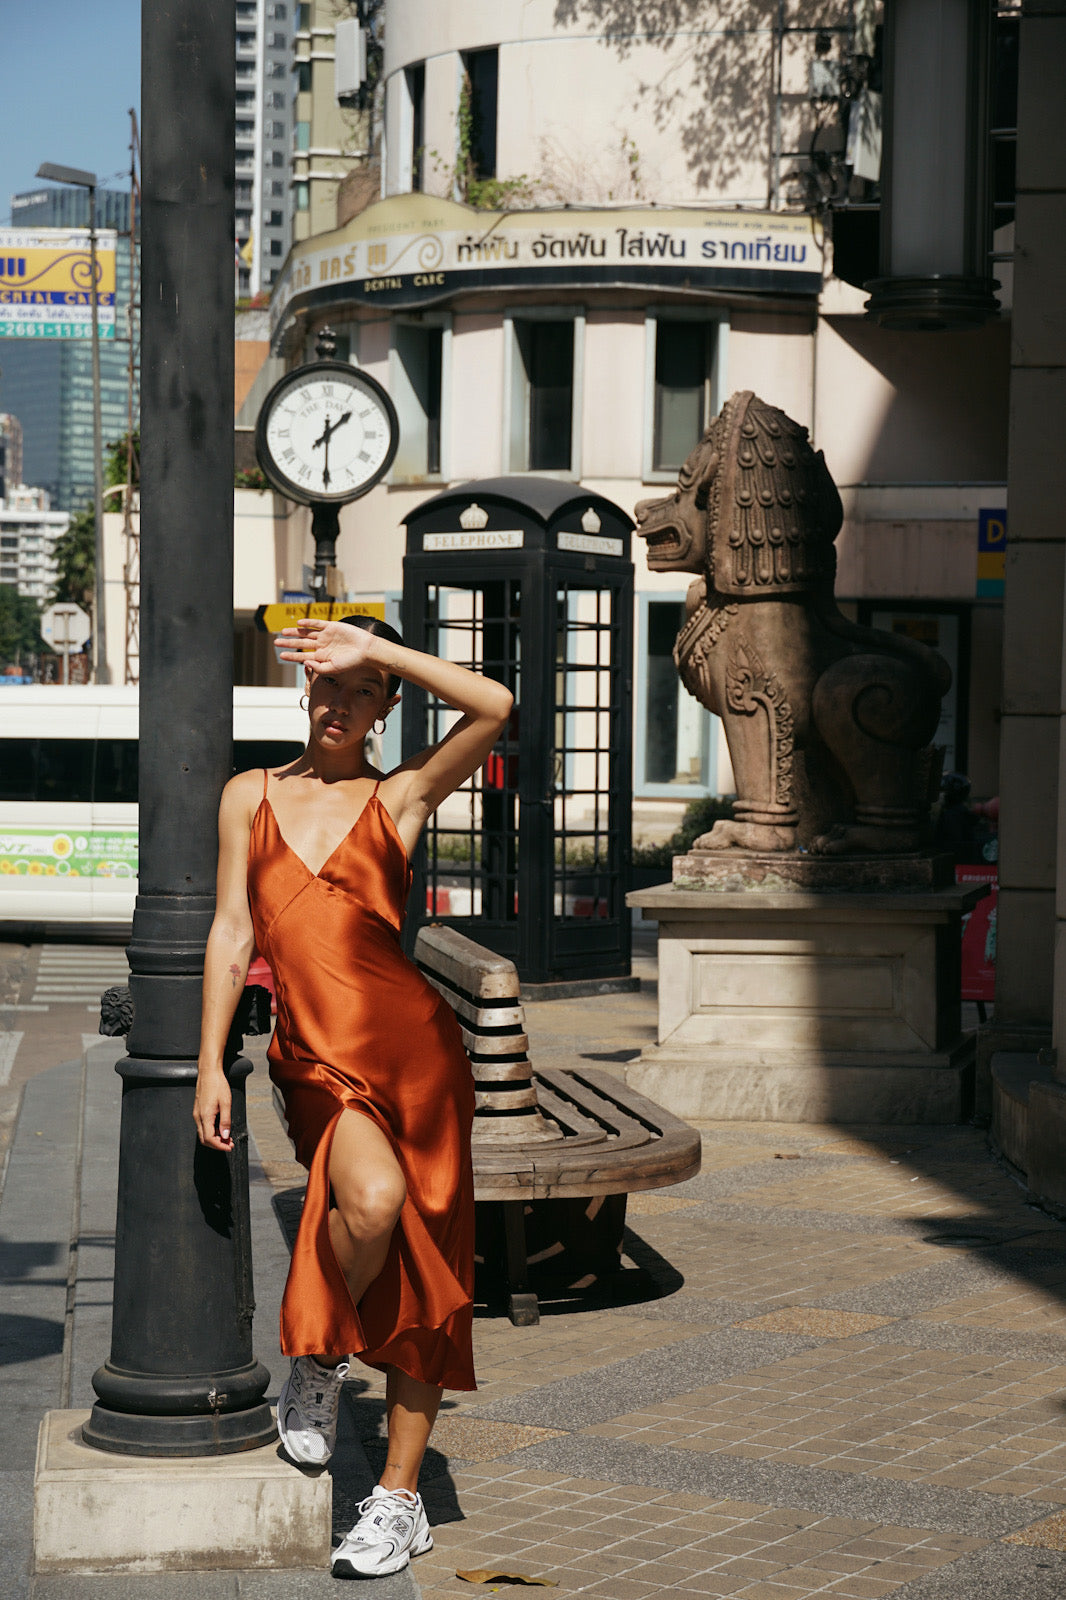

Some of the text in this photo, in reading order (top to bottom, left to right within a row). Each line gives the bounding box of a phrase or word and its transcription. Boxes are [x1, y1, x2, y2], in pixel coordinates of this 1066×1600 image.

[531, 232, 607, 259] จัดฟัน
[615, 228, 687, 259] ใส่ฟัน
[701, 236, 807, 263] รากเทียม
[432, 533, 516, 548] TELEPHONE
[564, 535, 617, 553] TELEPHONE
[341, 606, 369, 615] PARK
